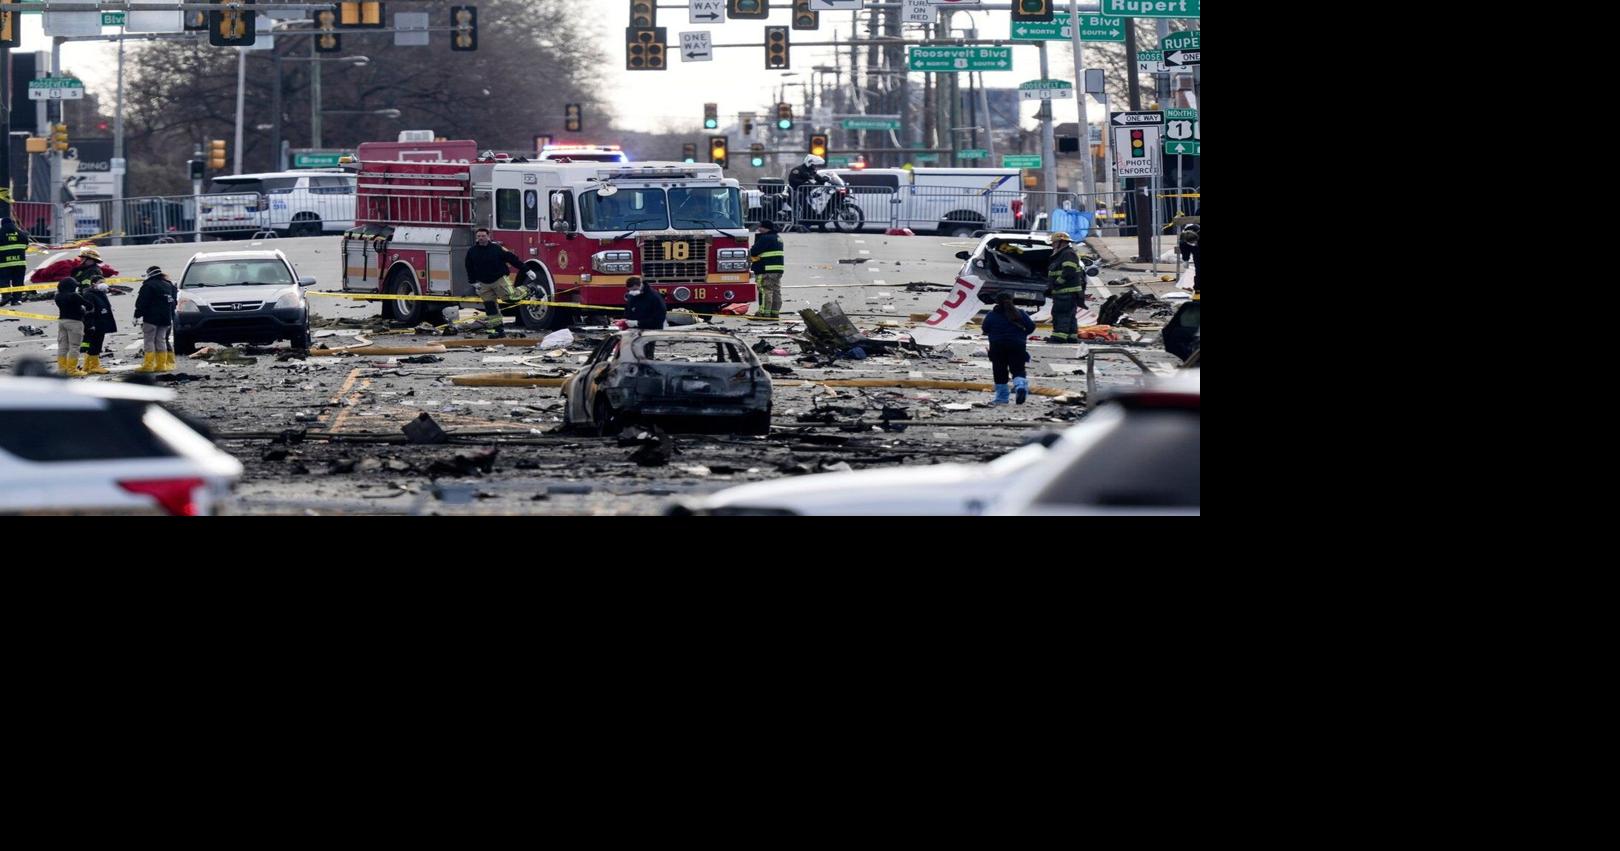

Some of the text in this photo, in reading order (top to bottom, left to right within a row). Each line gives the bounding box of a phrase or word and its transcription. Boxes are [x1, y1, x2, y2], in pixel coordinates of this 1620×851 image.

[1111, 0, 1187, 13] Rupert
[104, 15, 125, 24] Blv
[1089, 17, 1120, 26] Blvd
[913, 49, 1008, 58] Roosevelt Blvd
[1175, 123, 1183, 136] 1
[662, 241, 689, 260] 18
[694, 288, 706, 299] 18
